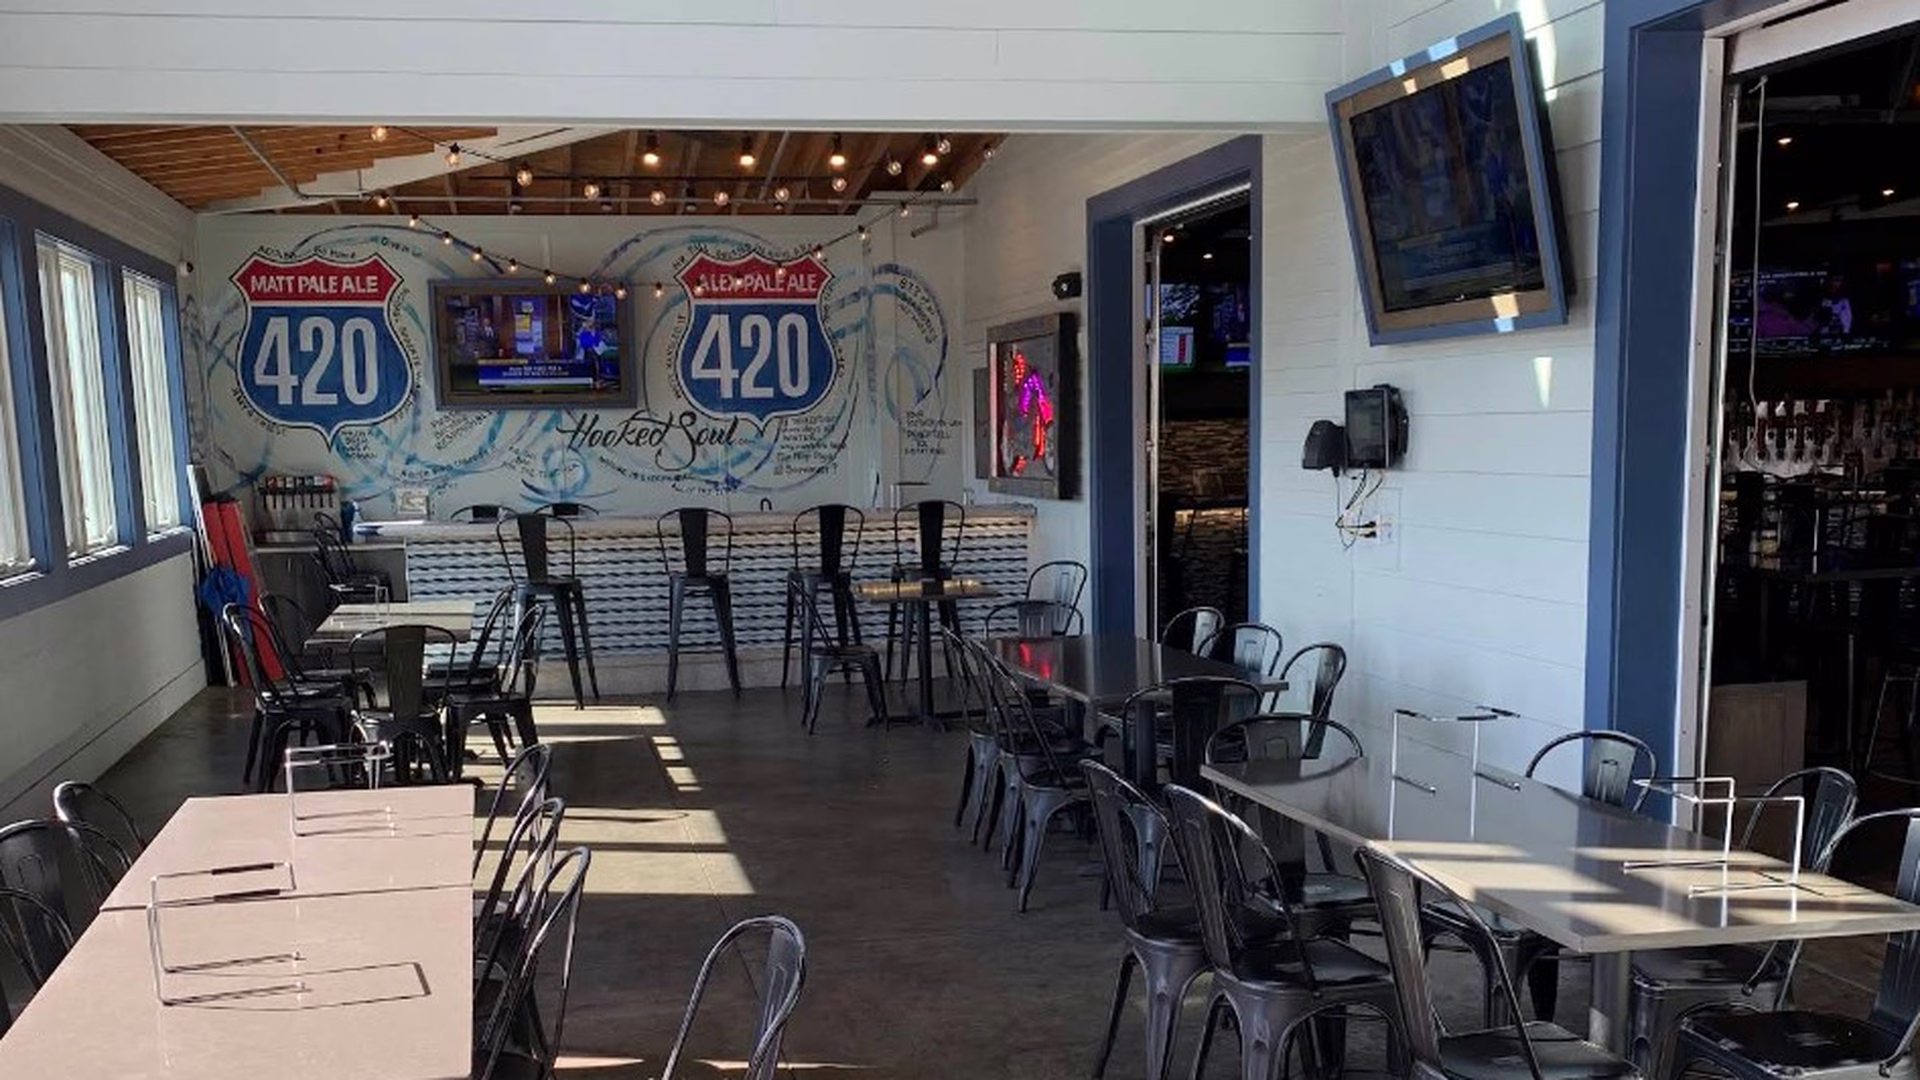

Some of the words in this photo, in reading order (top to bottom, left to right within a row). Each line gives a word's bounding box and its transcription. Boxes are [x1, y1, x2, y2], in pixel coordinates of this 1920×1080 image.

[251, 275, 295, 294] MATT
[298, 275, 338, 294] PALE
[341, 275, 378, 293] ALE
[699, 273, 737, 292] ALEX
[745, 273, 784, 293] PALE
[787, 273, 818, 292] ALE
[254, 316, 379, 405] 420
[691, 312, 810, 399] 420
[556, 410, 674, 450] Hooked
[655, 411, 739, 472] Soul
